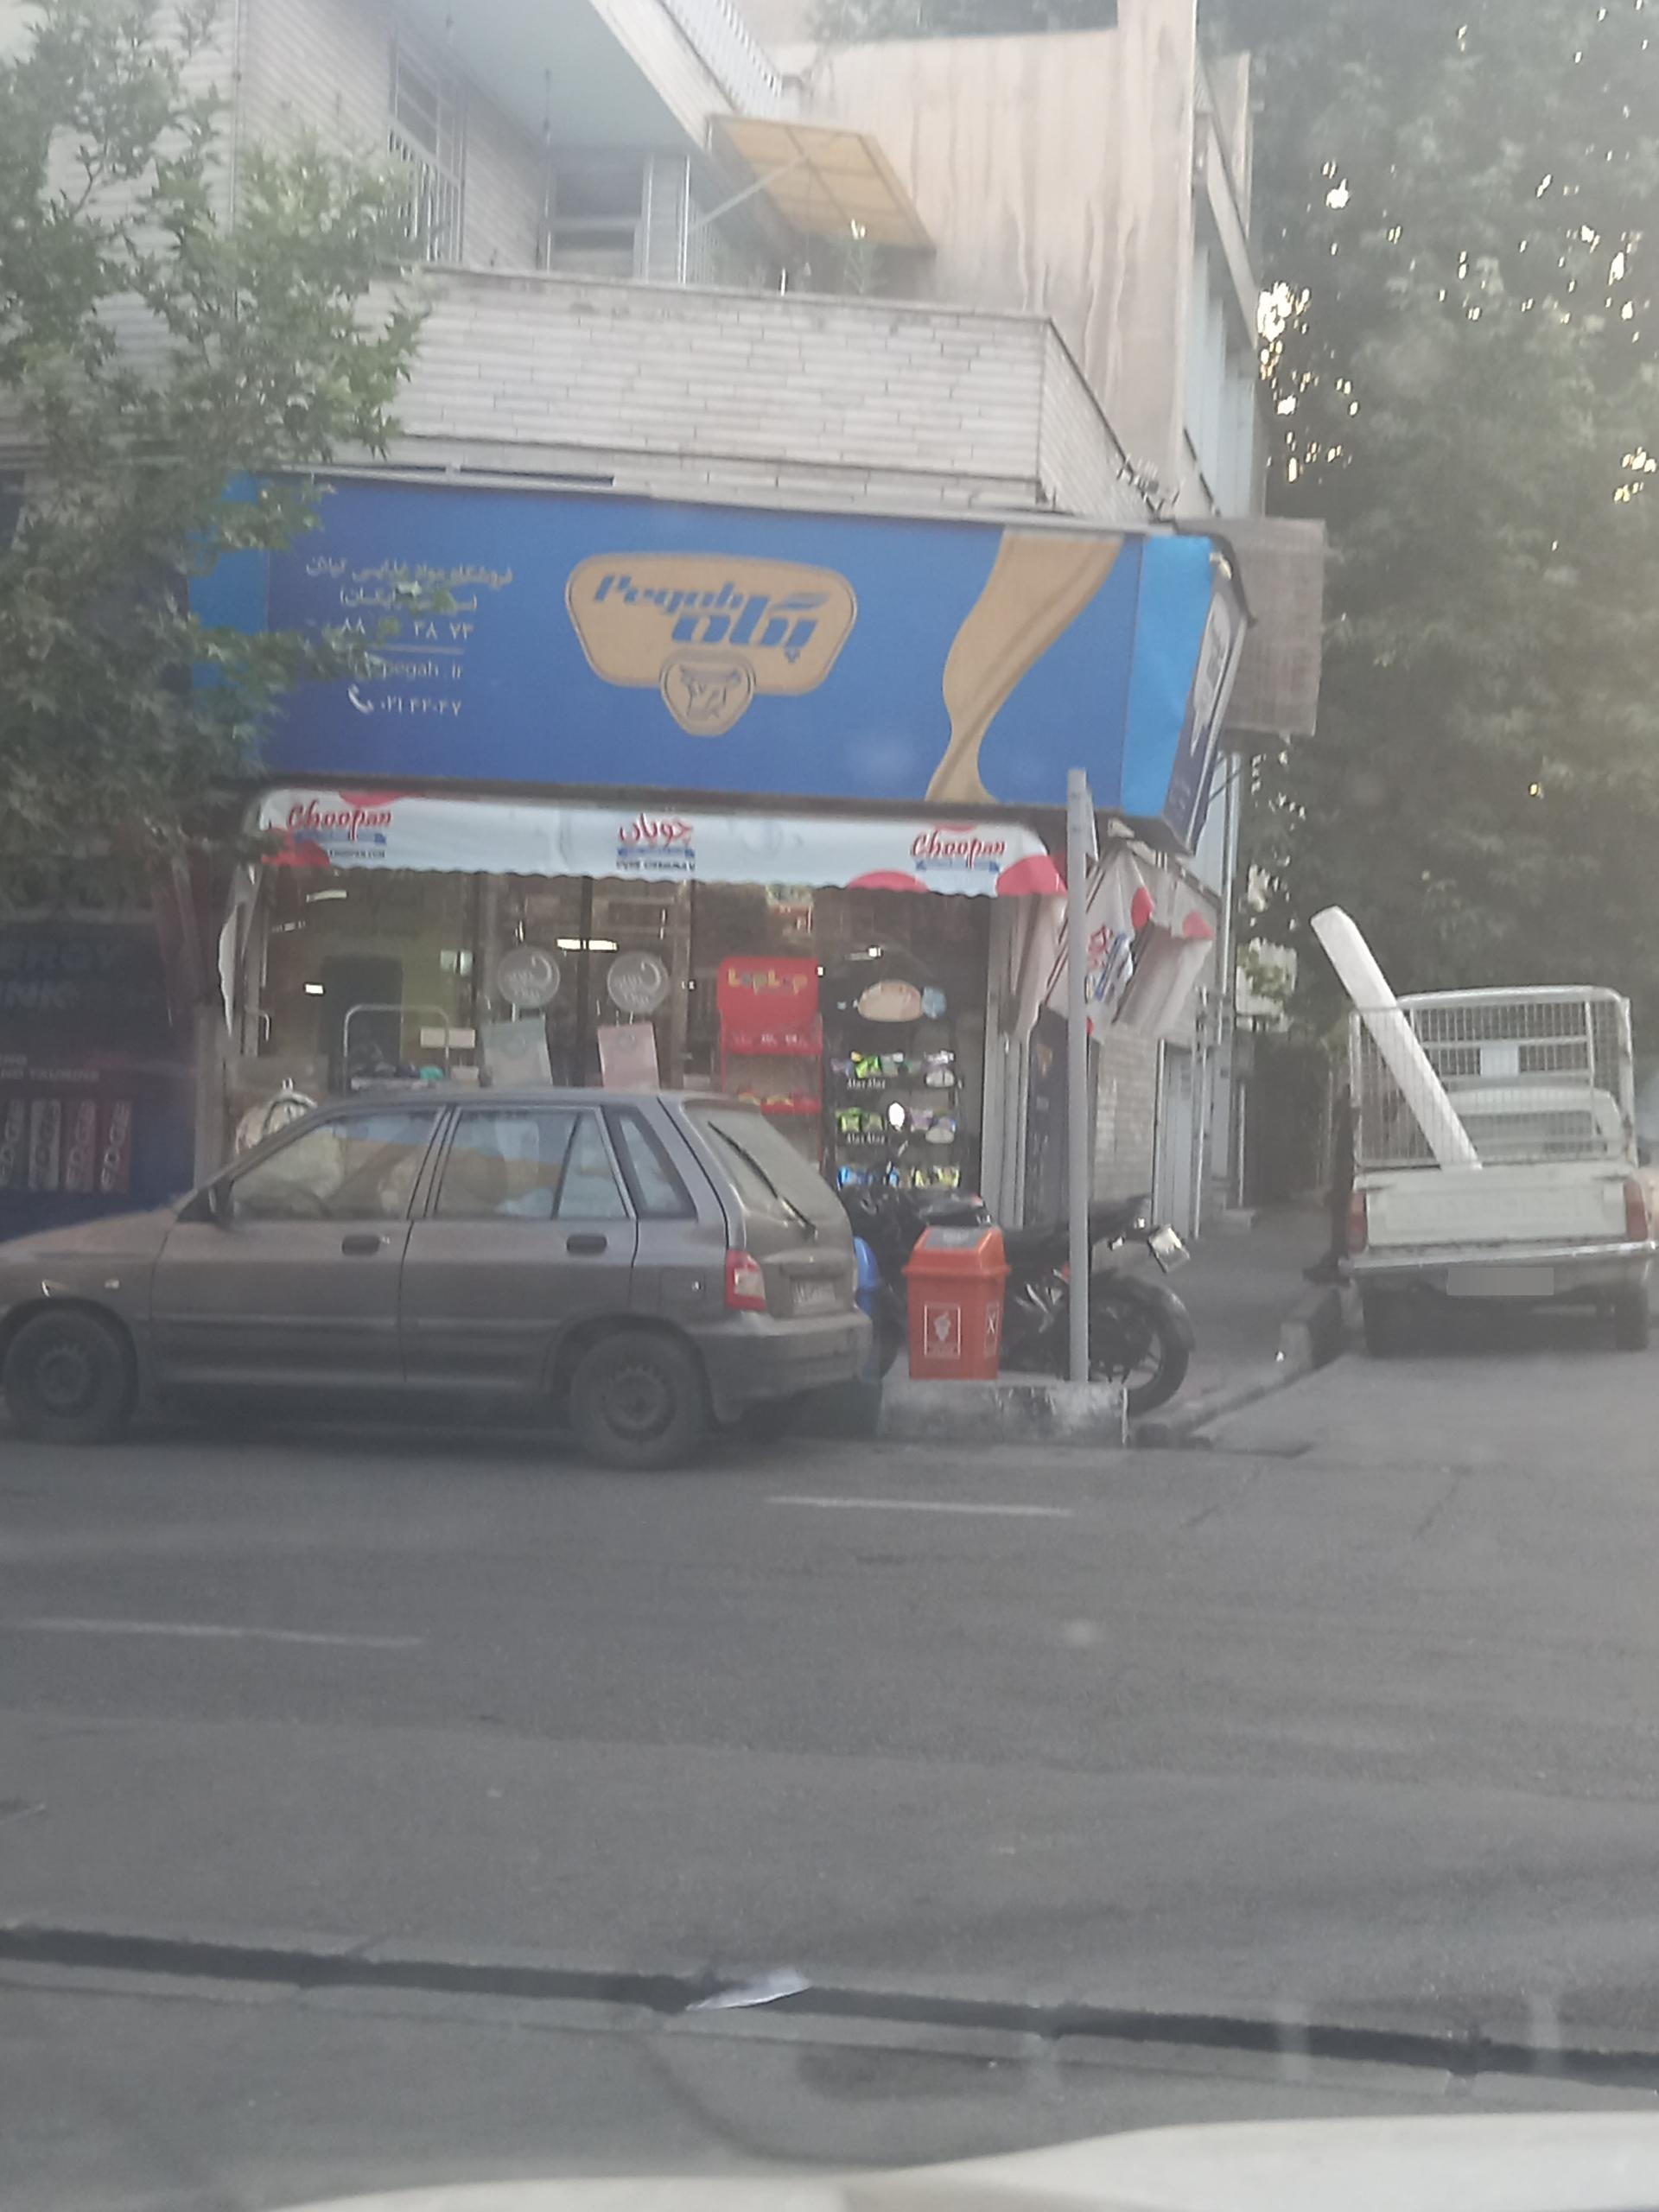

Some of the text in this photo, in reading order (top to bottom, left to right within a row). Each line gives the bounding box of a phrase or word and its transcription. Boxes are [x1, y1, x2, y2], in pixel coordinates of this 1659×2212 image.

[594, 575, 745, 614] Pegah
[288, 798, 392, 843] Choopan
[618, 812, 695, 849] چوپان
[910, 829, 1007, 870] Choopan
[100, 1099, 131, 1193] EDGE
